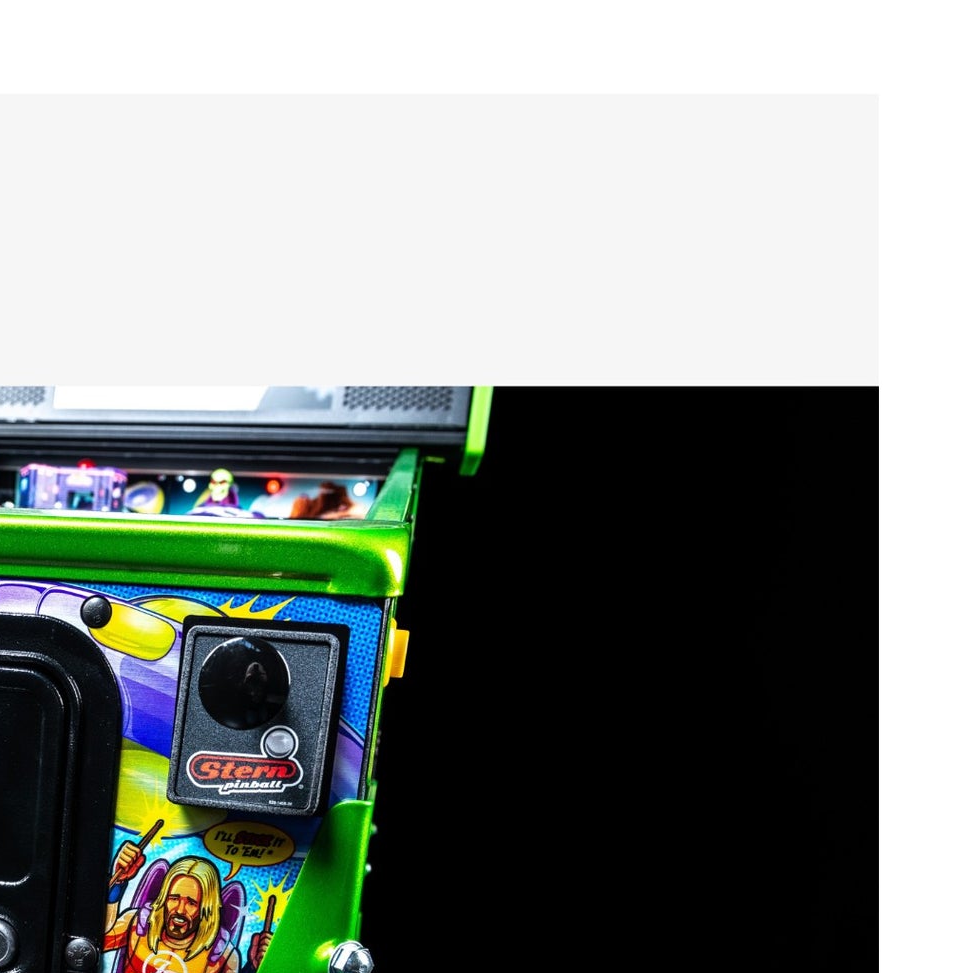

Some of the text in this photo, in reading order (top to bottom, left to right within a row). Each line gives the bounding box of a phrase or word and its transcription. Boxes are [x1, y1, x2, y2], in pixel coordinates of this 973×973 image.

[200, 761, 289, 780] Stern
[223, 780, 283, 791] pinball
[214, 830, 233, 843] I'LL
[272, 836, 287, 848] IT
[225, 844, 239, 856] TO
